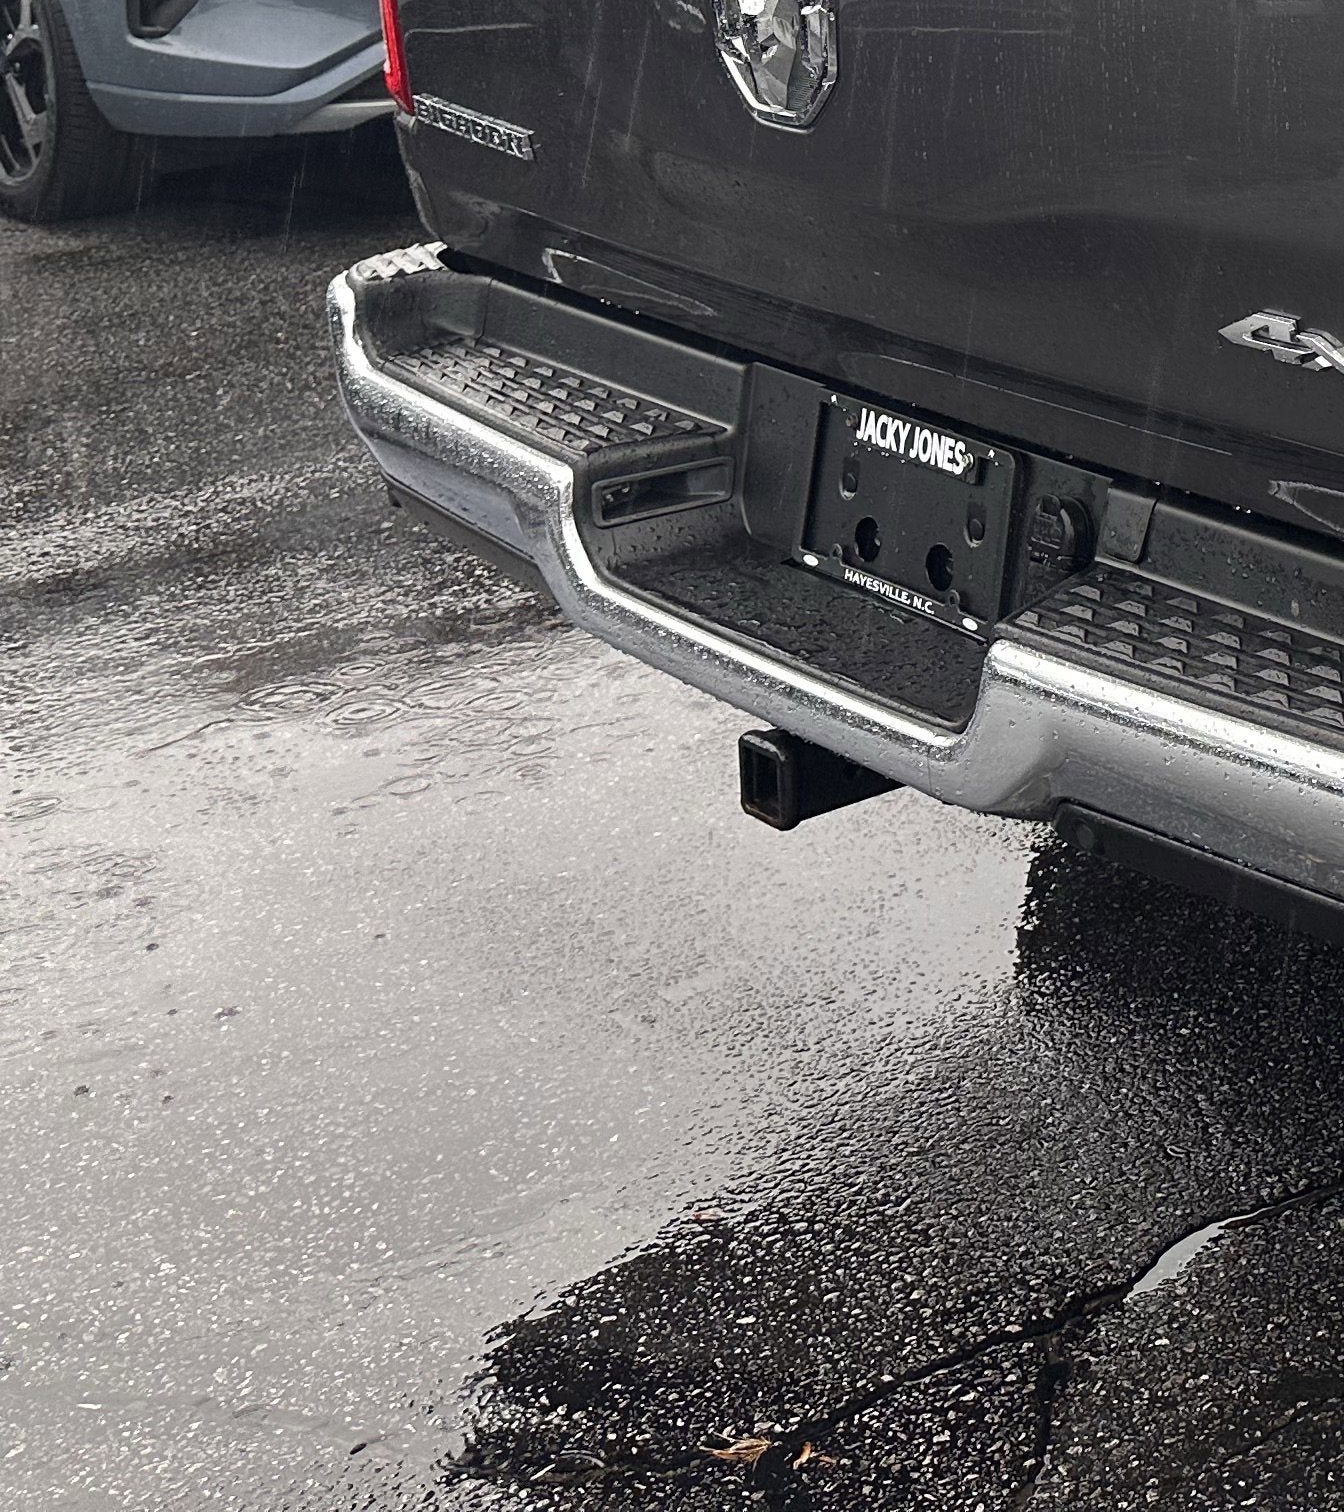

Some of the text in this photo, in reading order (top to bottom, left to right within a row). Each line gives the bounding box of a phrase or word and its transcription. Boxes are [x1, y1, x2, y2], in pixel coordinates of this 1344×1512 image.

[856, 407, 966, 476] JACKY JONES
[912, 596, 935, 615] N.C.
